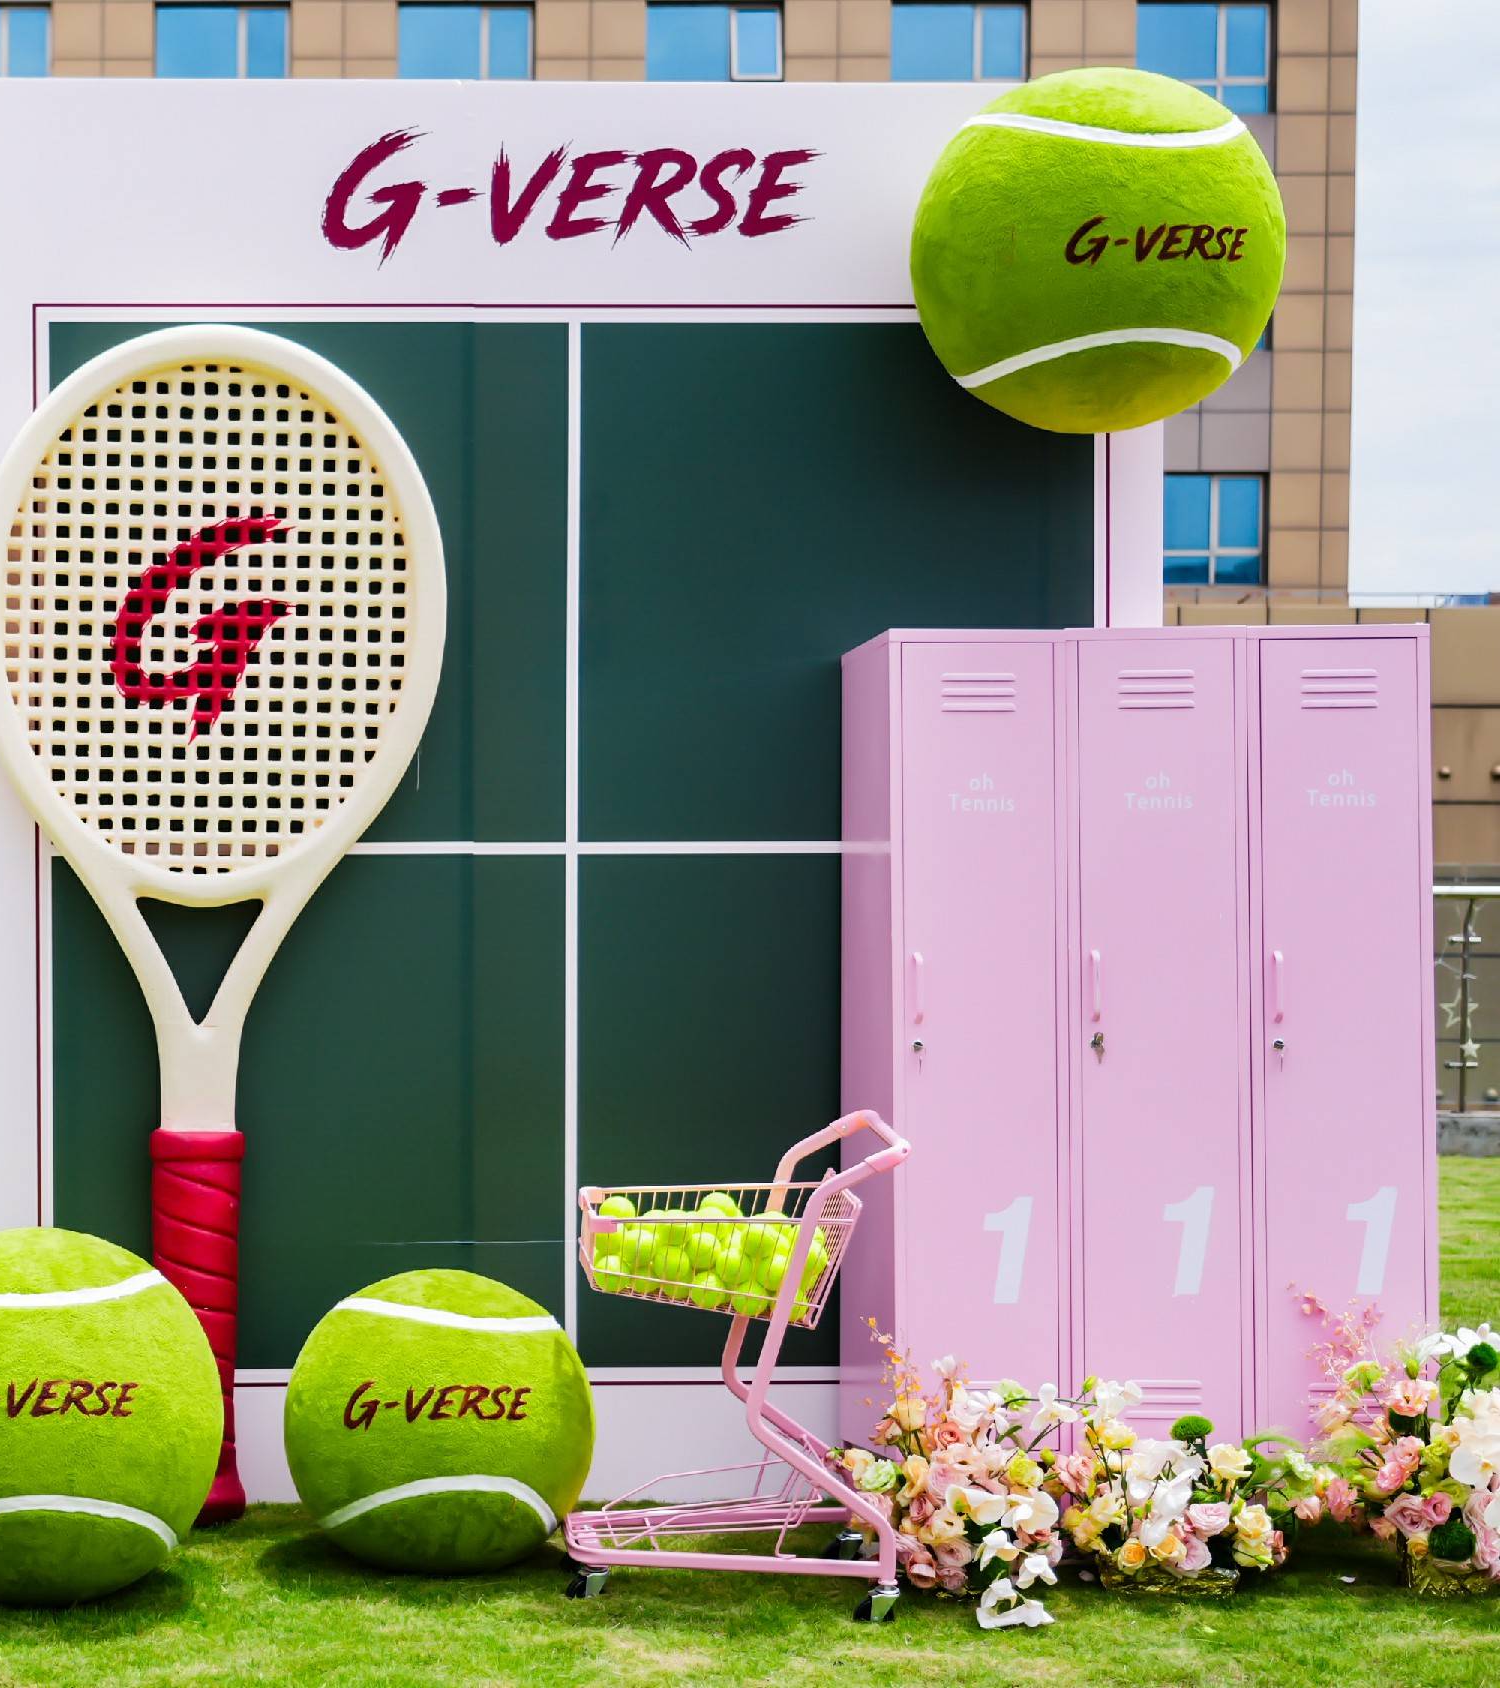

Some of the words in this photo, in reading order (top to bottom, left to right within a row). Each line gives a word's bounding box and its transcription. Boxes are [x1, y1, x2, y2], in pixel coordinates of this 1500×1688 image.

[320, 126, 822, 268] G-VERSE
[1065, 216, 1248, 264] G-VERSE
[110, 513, 297, 745] G
[969, 773, 994, 791] oh
[1124, 792, 1193, 810] Tennis
[1145, 772, 1171, 789] oh
[1306, 789, 1376, 808] Tennis
[1328, 769, 1354, 787] oh
[948, 793, 1014, 812] Tennis
[983, 1196, 1033, 1304] 1
[1163, 1187, 1214, 1296] 1
[1347, 1187, 1398, 1296] 1
[344, 1381, 532, 1430] G-VERSE
